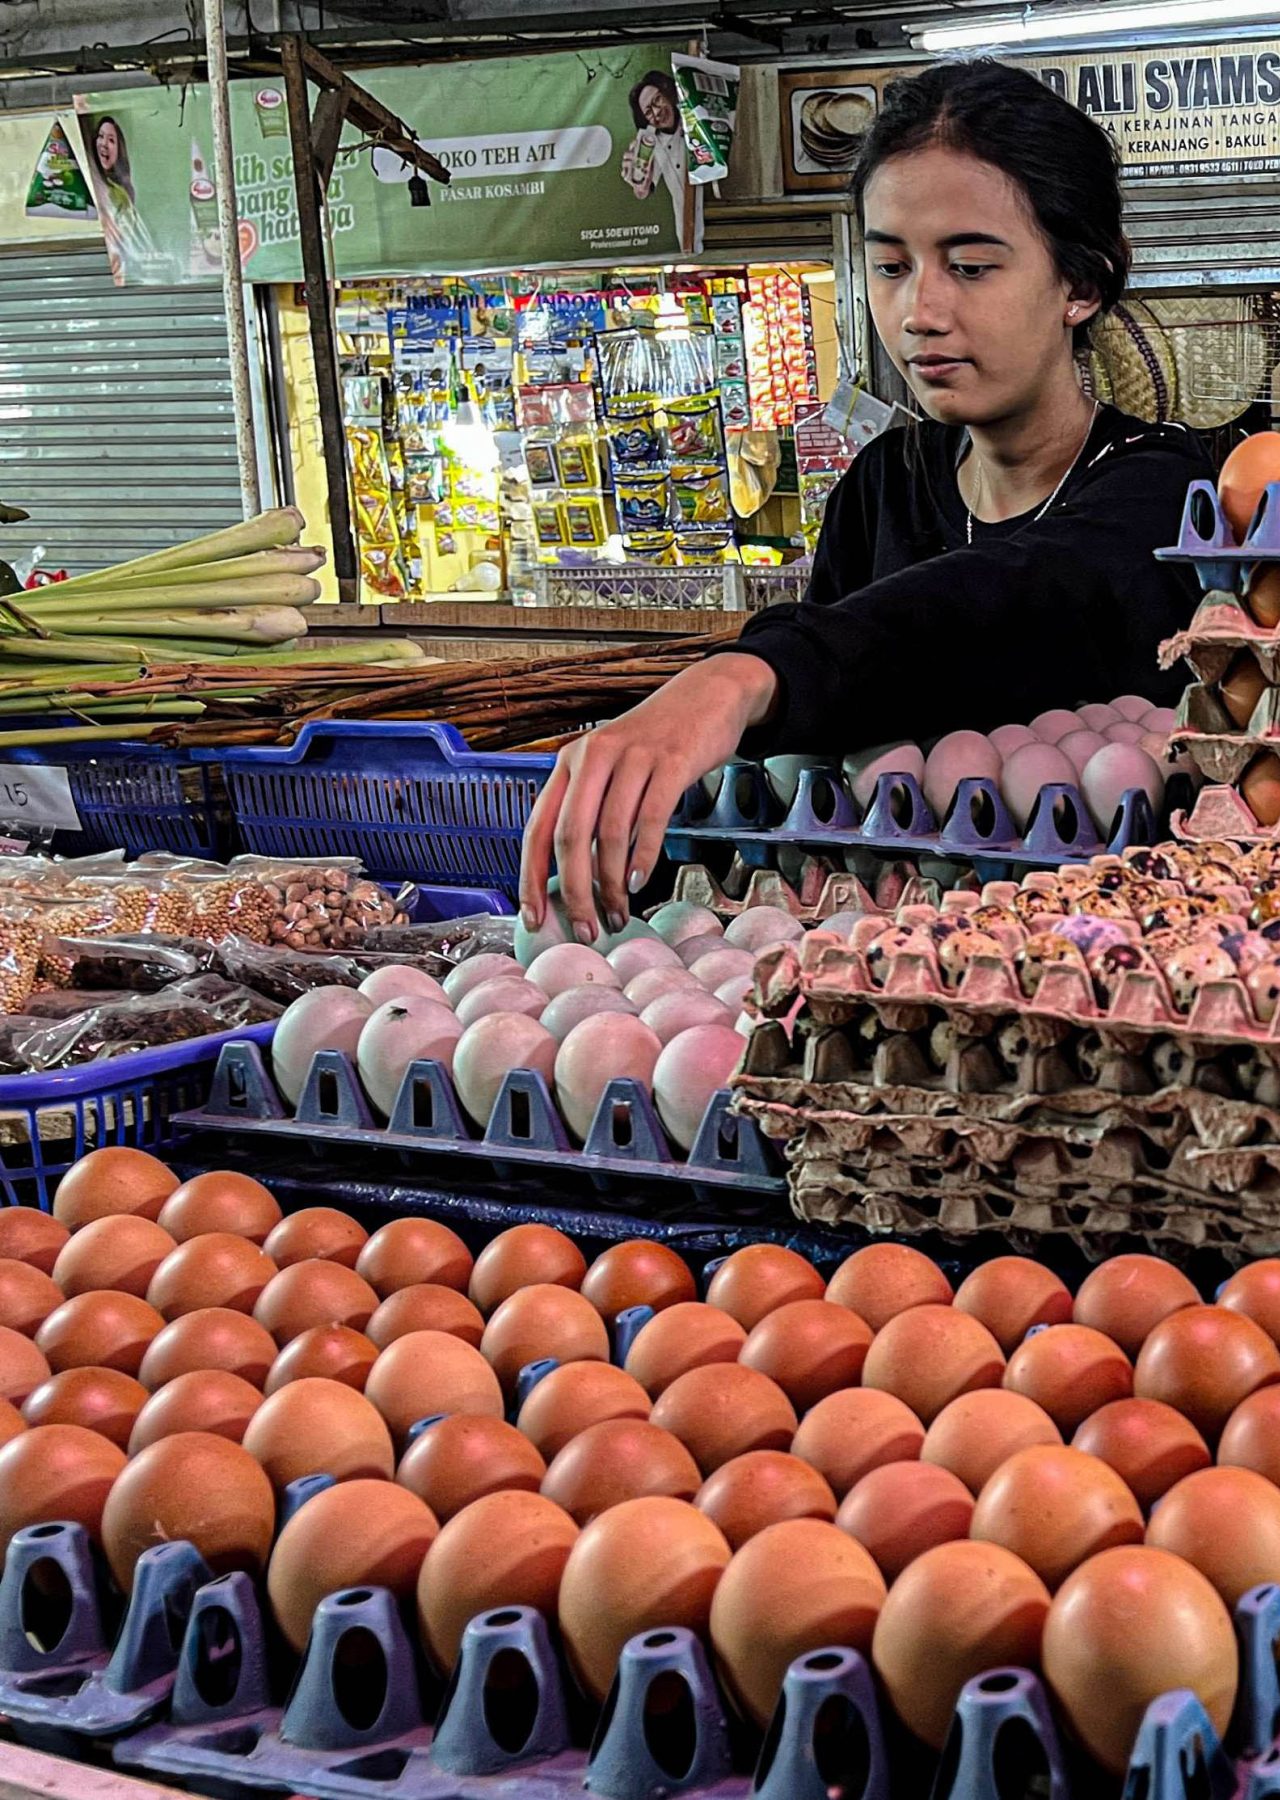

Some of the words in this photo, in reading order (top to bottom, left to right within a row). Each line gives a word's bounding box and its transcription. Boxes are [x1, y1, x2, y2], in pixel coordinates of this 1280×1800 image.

[1077, 64, 1137, 113] ALI
[1124, 115, 1213, 132] KERAJINAN
[1128, 137, 1209, 153] KERANJANG
[1225, 134, 1267, 149] BAKUL
[431, 149, 477, 168] OKO
[481, 146, 520, 166] TEH
[526, 143, 556, 163] ATI
[440, 184, 482, 202] PASAR
[485, 181, 545, 199] KOSAMBI
[580, 229, 604, 241] SISCA
[4, 782, 28, 807] 15
